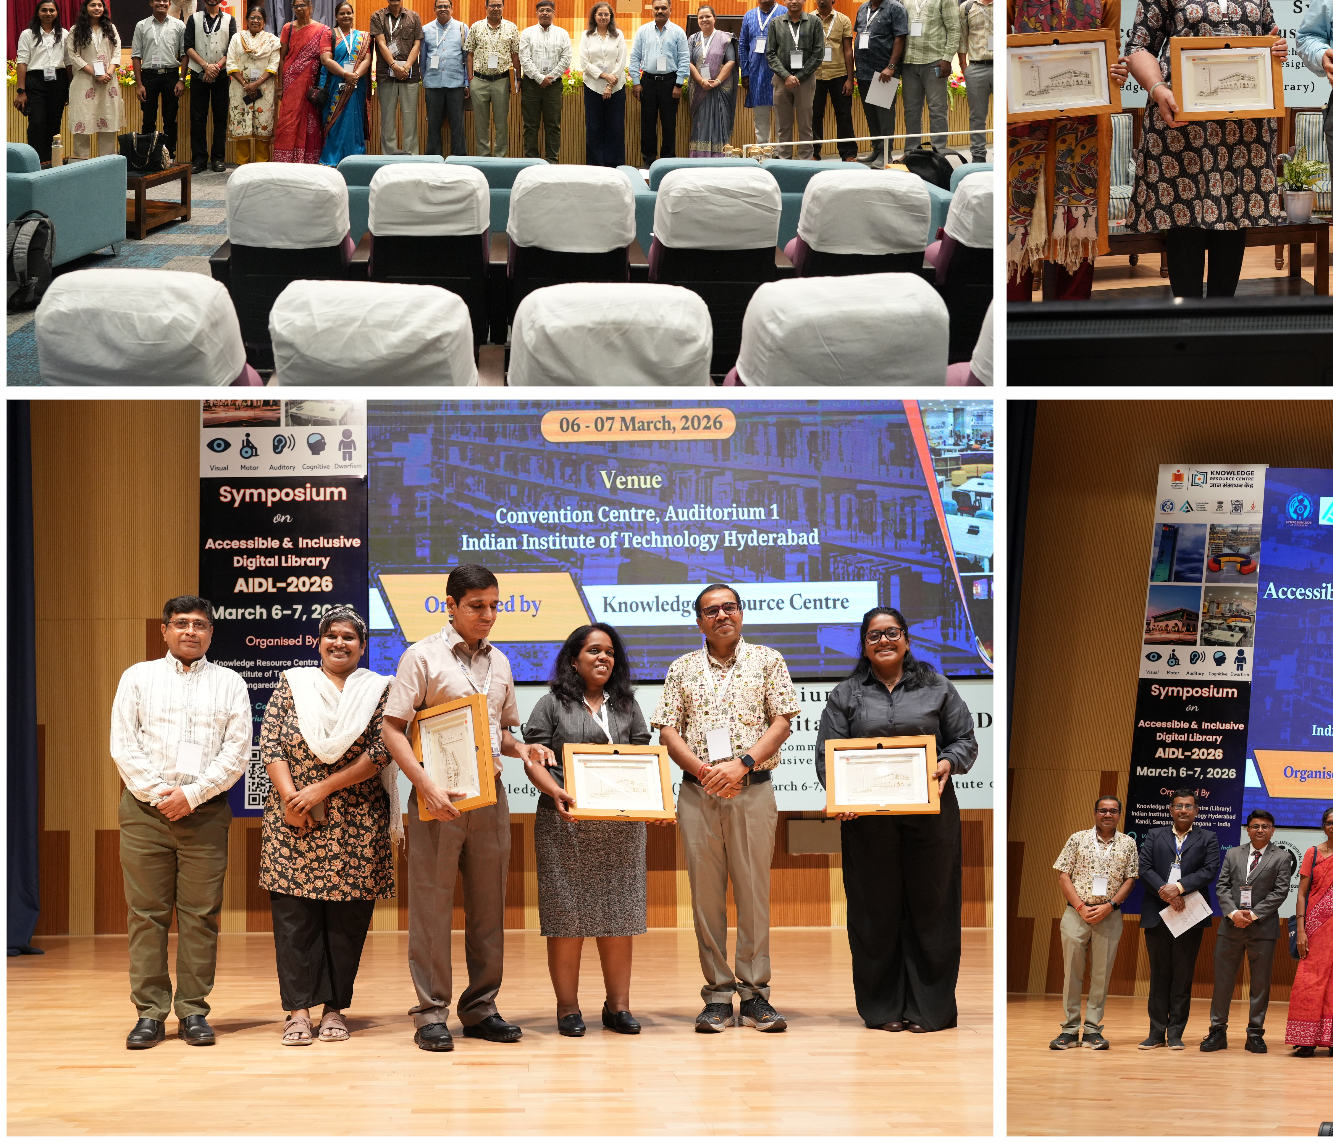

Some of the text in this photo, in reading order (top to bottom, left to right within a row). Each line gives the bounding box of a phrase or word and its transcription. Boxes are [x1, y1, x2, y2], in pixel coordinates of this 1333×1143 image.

[269, 464, 296, 472] Auditory
[302, 463, 330, 471] Cognitive
[600, 470, 662, 490] Venue
[219, 483, 347, 508] Symposium
[598, 505, 766, 524] Centre, Auditorium
[205, 536, 361, 550] Accessible & Inclusive
[233, 555, 330, 570] Digital Library
[234, 576, 332, 593] AIDL-2026
[789, 595, 849, 611] Centre
[246, 636, 304, 648] Organised
[1155, 748, 1223, 760] AIDL-2026
